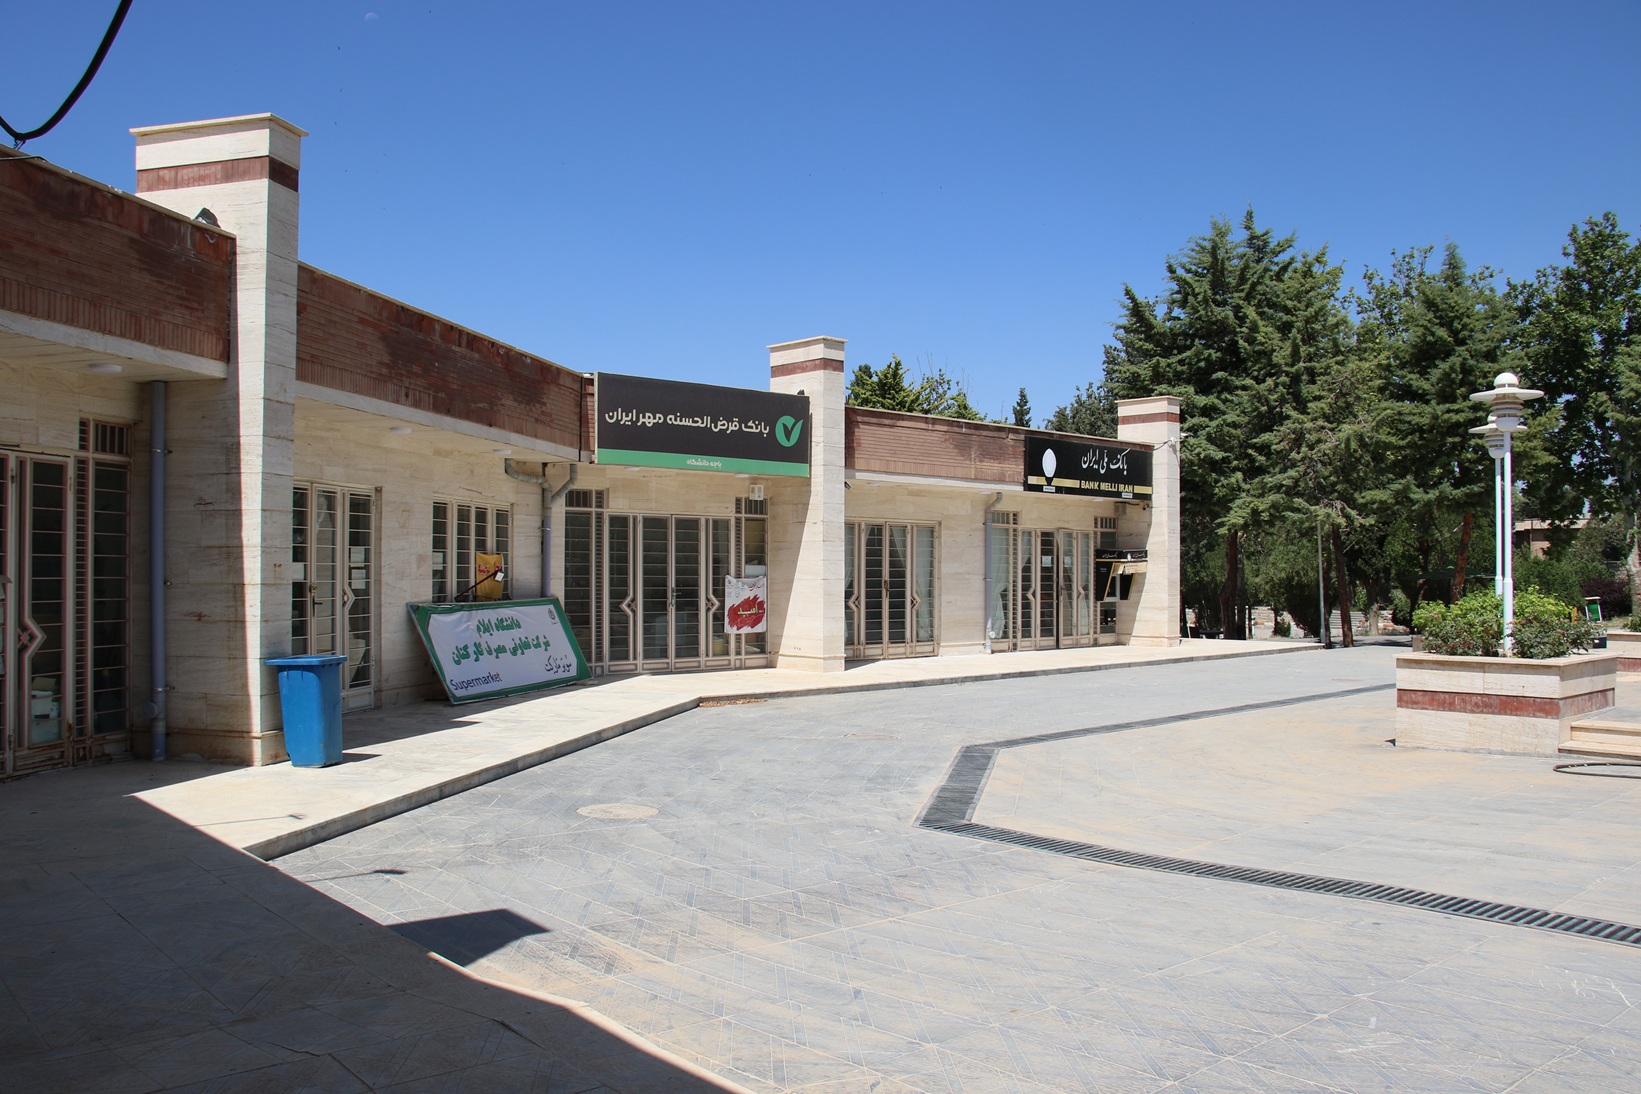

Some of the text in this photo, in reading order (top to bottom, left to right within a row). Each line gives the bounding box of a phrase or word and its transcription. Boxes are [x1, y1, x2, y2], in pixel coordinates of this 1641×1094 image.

[605, 408, 769, 437] بانک قرض الحسنه مهر ایران
[686, 458, 722, 470] باجه دانشگاه
[1081, 448, 1099, 469] ایران
[1109, 448, 1131, 475] بانک
[1081, 480, 1133, 493] BANK MELLI IRAN
[476, 616, 521, 638] دانشگاه ایلام
[483, 640, 508, 659] مصرف
[509, 636, 532, 656] تعاونی
[531, 635, 550, 652] شرکت
[450, 672, 502, 692] Supermarket
